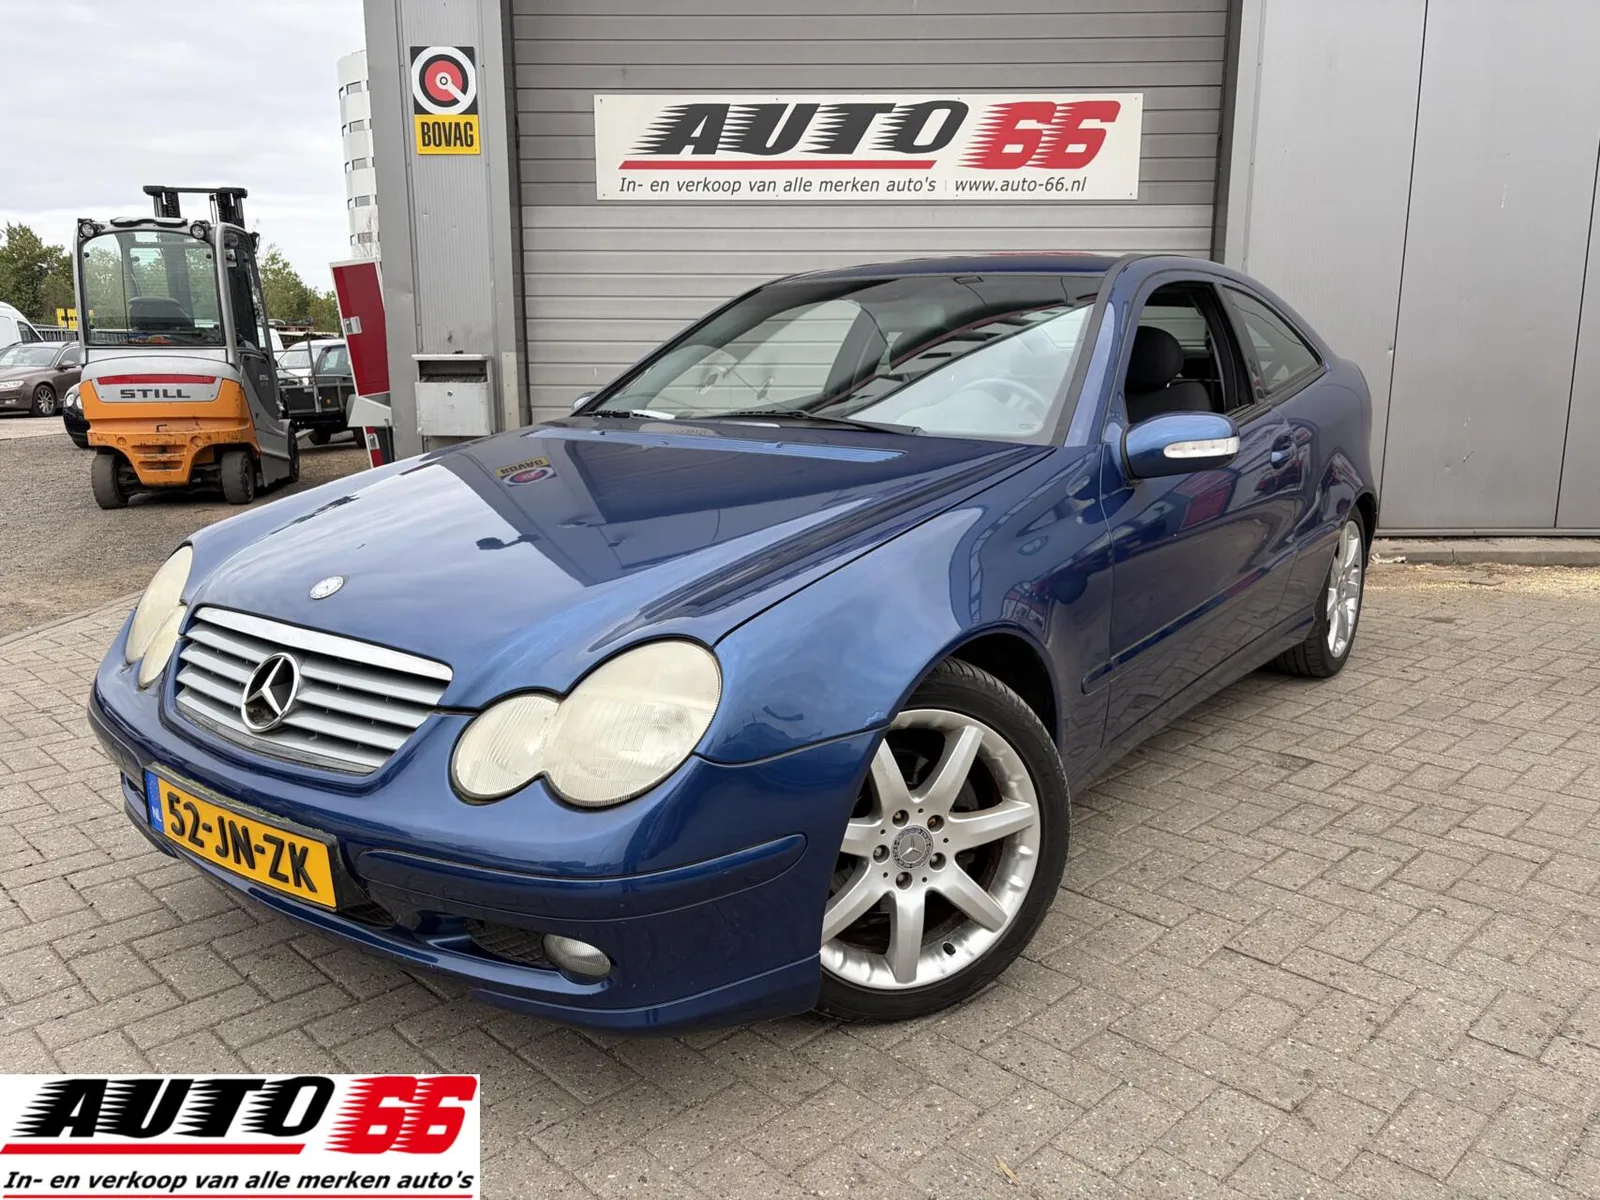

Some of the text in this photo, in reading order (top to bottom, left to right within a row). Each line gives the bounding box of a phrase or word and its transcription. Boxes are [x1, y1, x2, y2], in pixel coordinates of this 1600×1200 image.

[420, 121, 474, 148] BOVAG
[626, 100, 1120, 170] AUTO 66
[619, 176, 1087, 196] In- en verkoop van alle merken auto's www.auto-66.nl
[120, 388, 191, 399] STILL
[151, 805, 163, 823] NL
[166, 790, 318, 893] 52-JN-ZK
